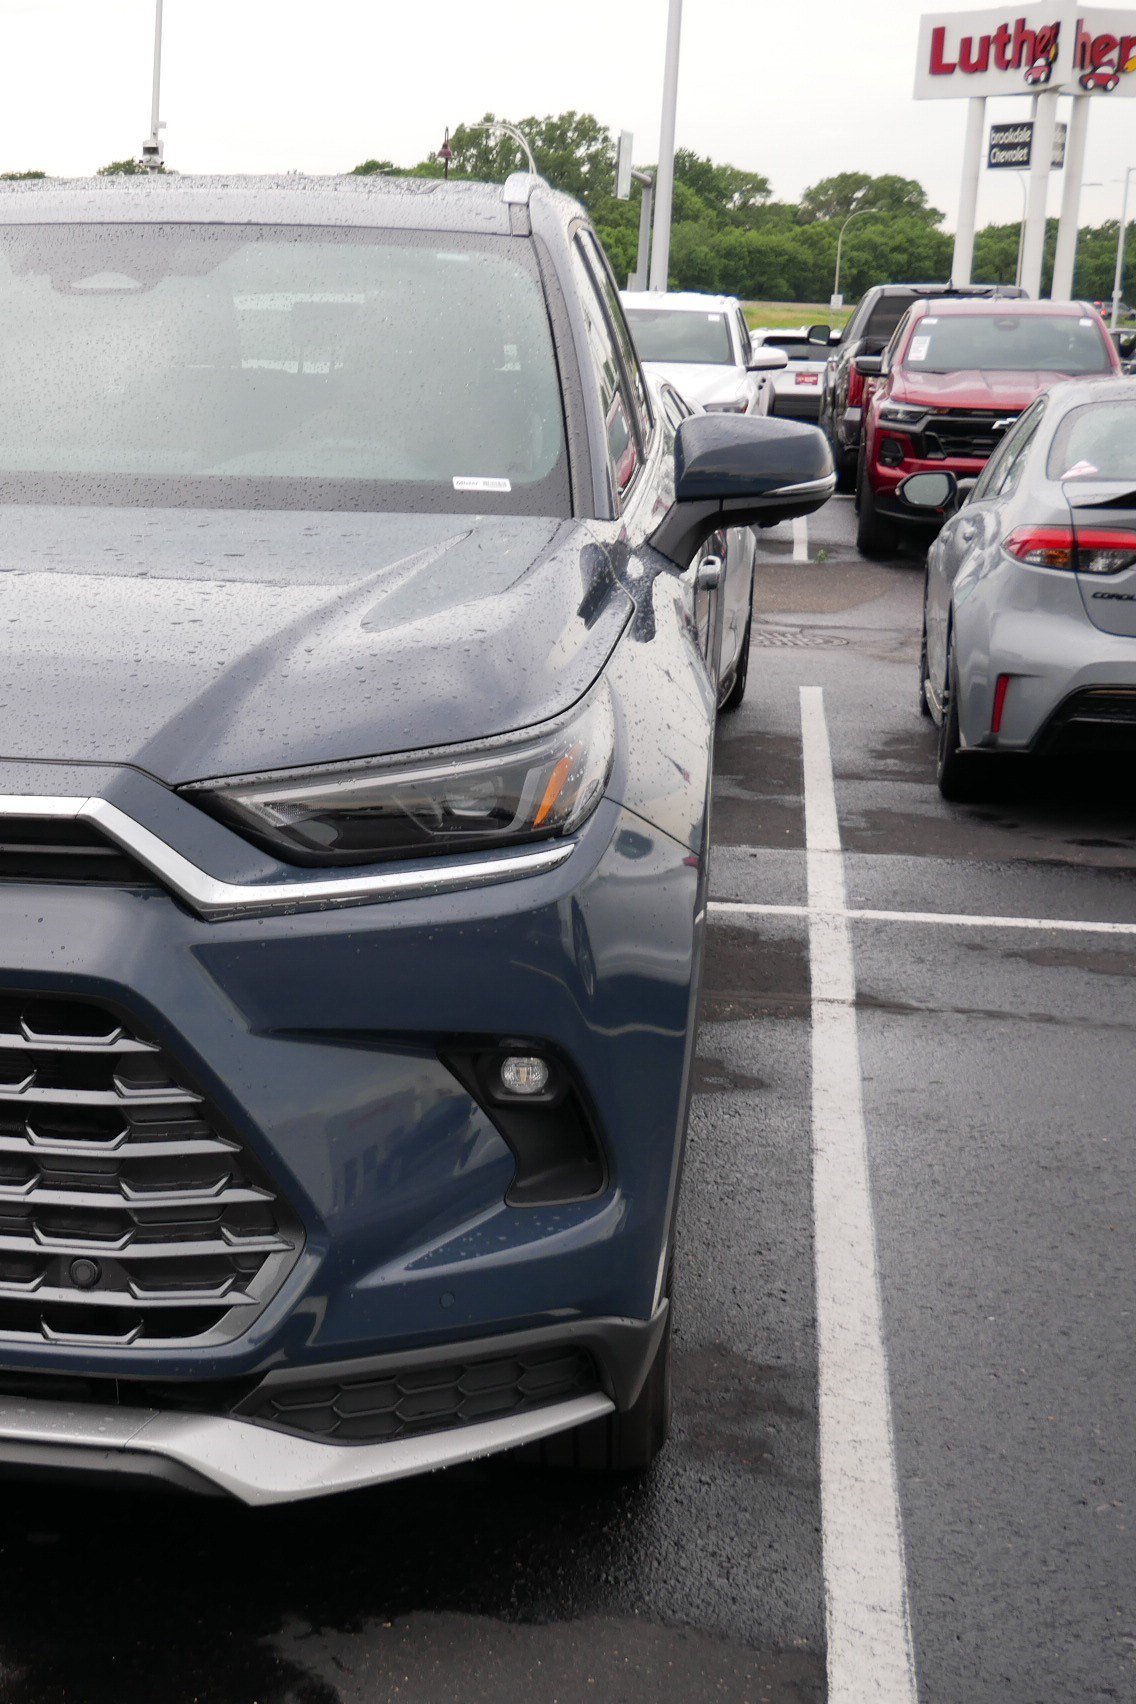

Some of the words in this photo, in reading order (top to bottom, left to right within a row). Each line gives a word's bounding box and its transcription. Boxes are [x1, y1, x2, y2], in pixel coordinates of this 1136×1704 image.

[929, 18, 1061, 75] Luther
[1072, 19, 1136, 72] her
[990, 146, 1028, 163] Chevrolet
